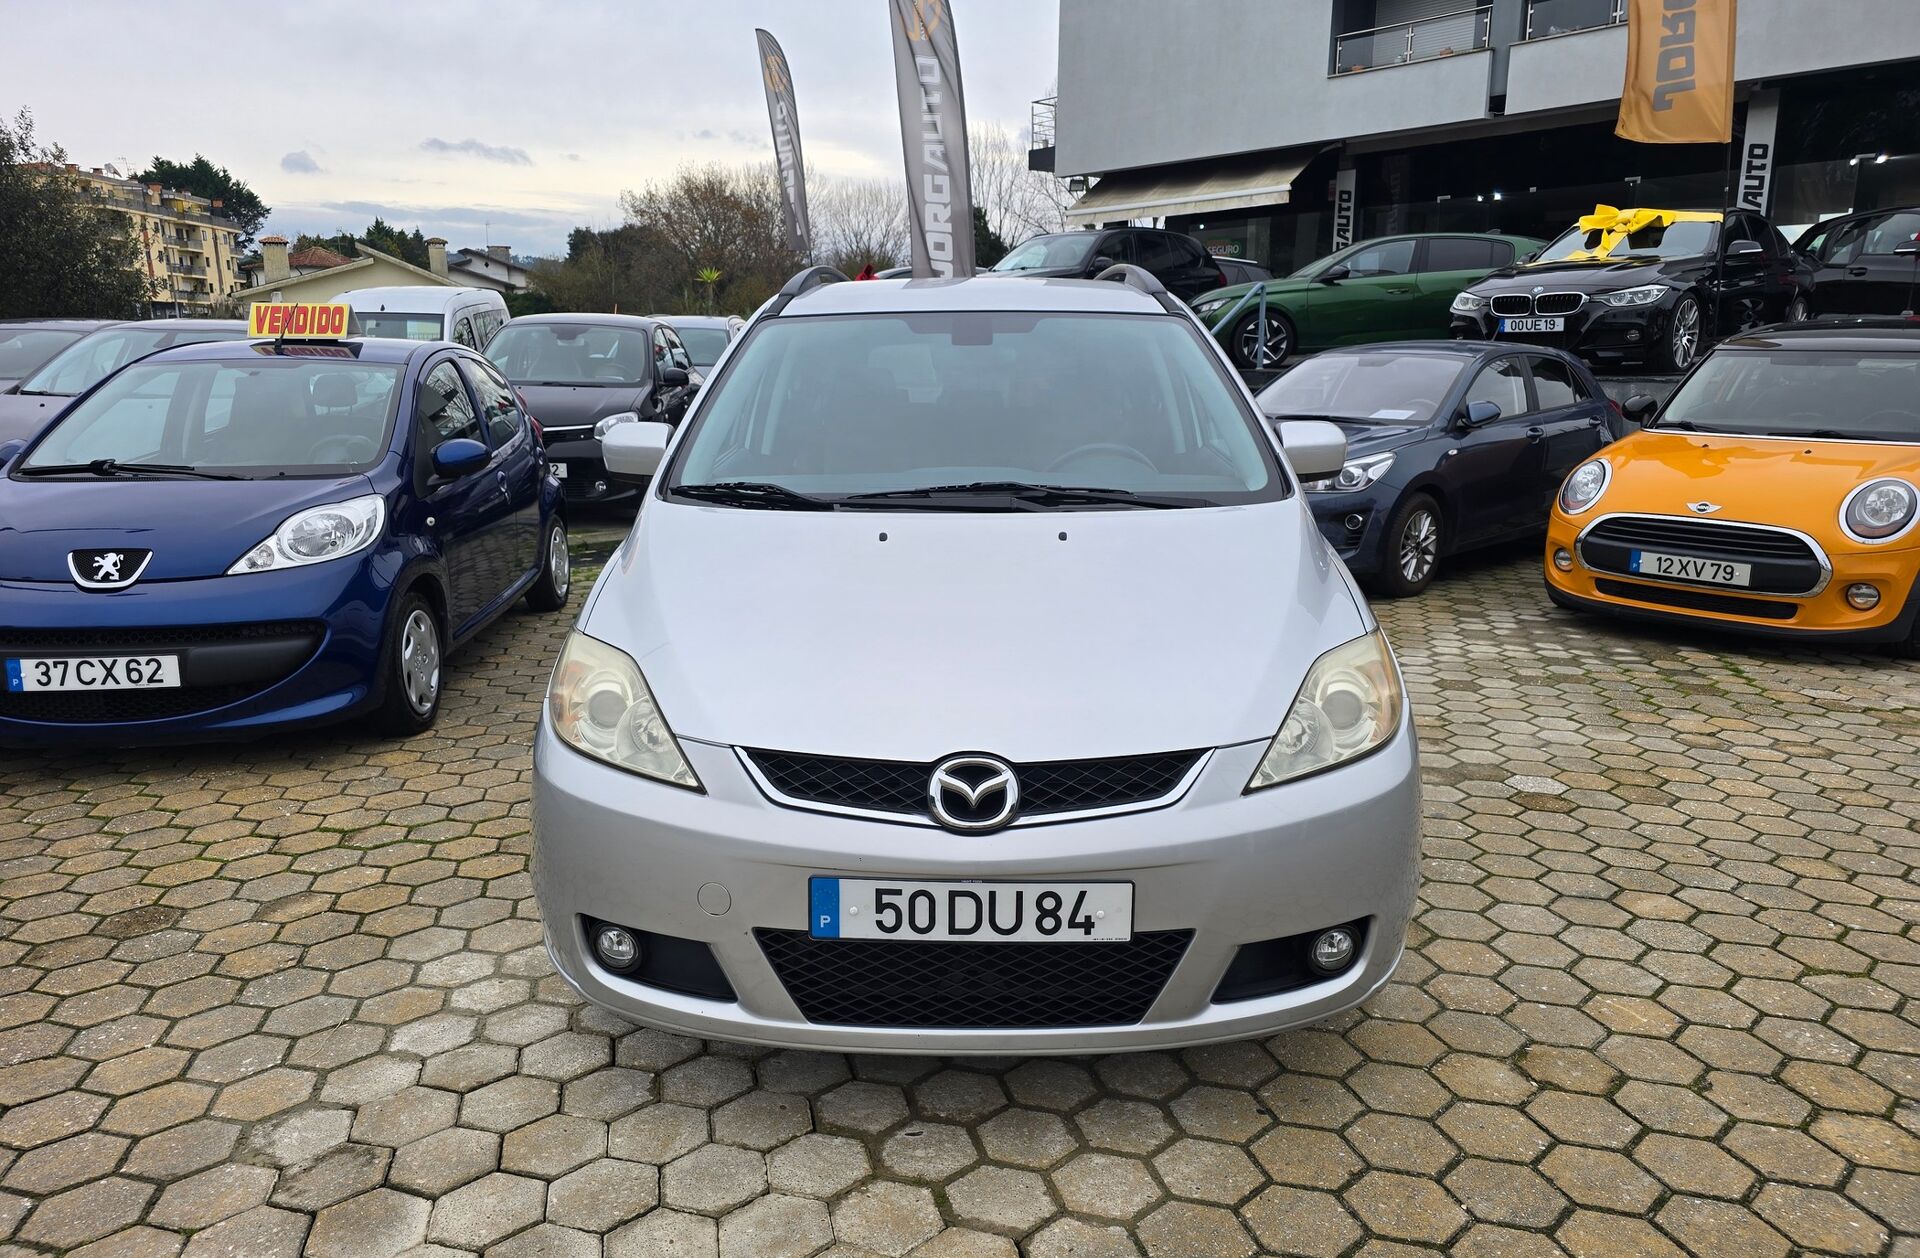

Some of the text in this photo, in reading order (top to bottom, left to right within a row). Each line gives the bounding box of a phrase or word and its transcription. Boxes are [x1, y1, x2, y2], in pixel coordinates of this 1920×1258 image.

[1742, 143, 1769, 209] AUTO
[1207, 244, 1240, 255] SEGURO
[256, 306, 344, 334] VENDIDO
[1656, 556, 1674, 574] 12
[1676, 558, 1706, 578] XV
[1710, 563, 1735, 581] 79
[12, 657, 164, 687] P 37 CX 62
[819, 887, 1096, 937] P 50 DU 84
